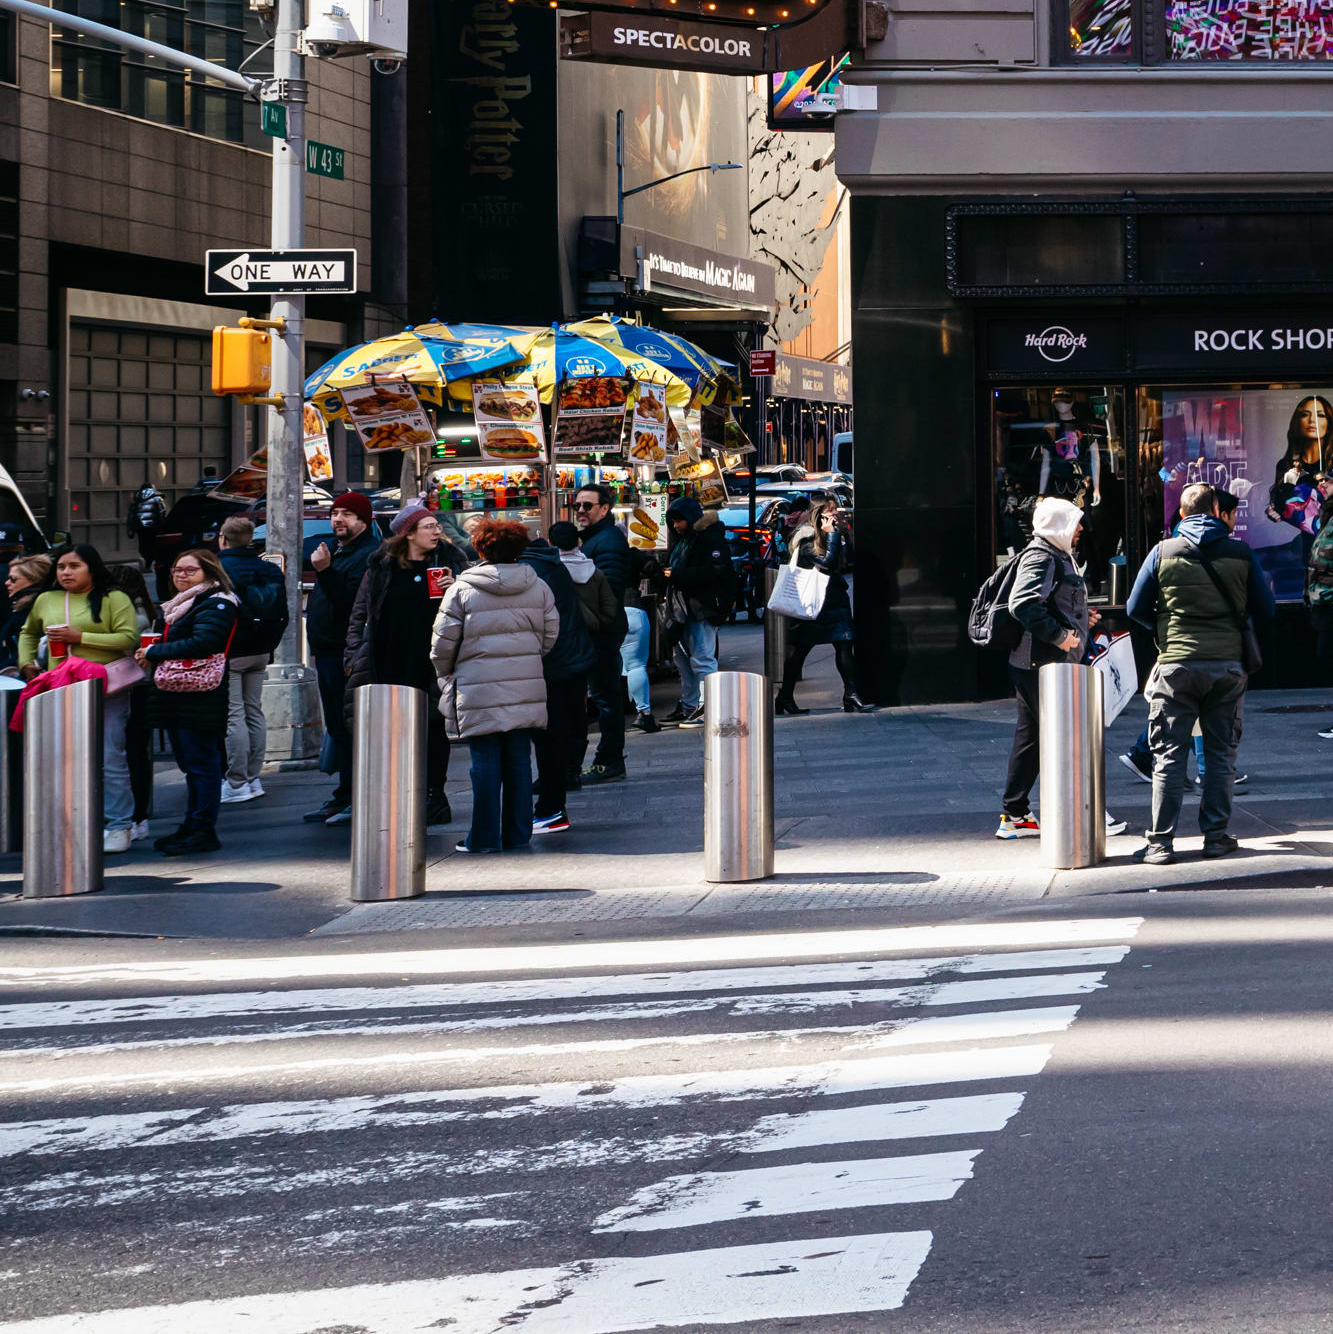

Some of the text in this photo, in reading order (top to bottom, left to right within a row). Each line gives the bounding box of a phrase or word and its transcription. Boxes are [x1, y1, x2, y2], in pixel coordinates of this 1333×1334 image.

[457, 1, 520, 70] arry
[613, 27, 750, 57] SPECTACOLOR
[442, 74, 531, 180] Potter
[309, 145, 343, 172] W 43 St
[230, 263, 336, 280] ONE WAY
[1025, 333, 1087, 348] Hard Rock
[1194, 329, 1264, 351] ROCK
